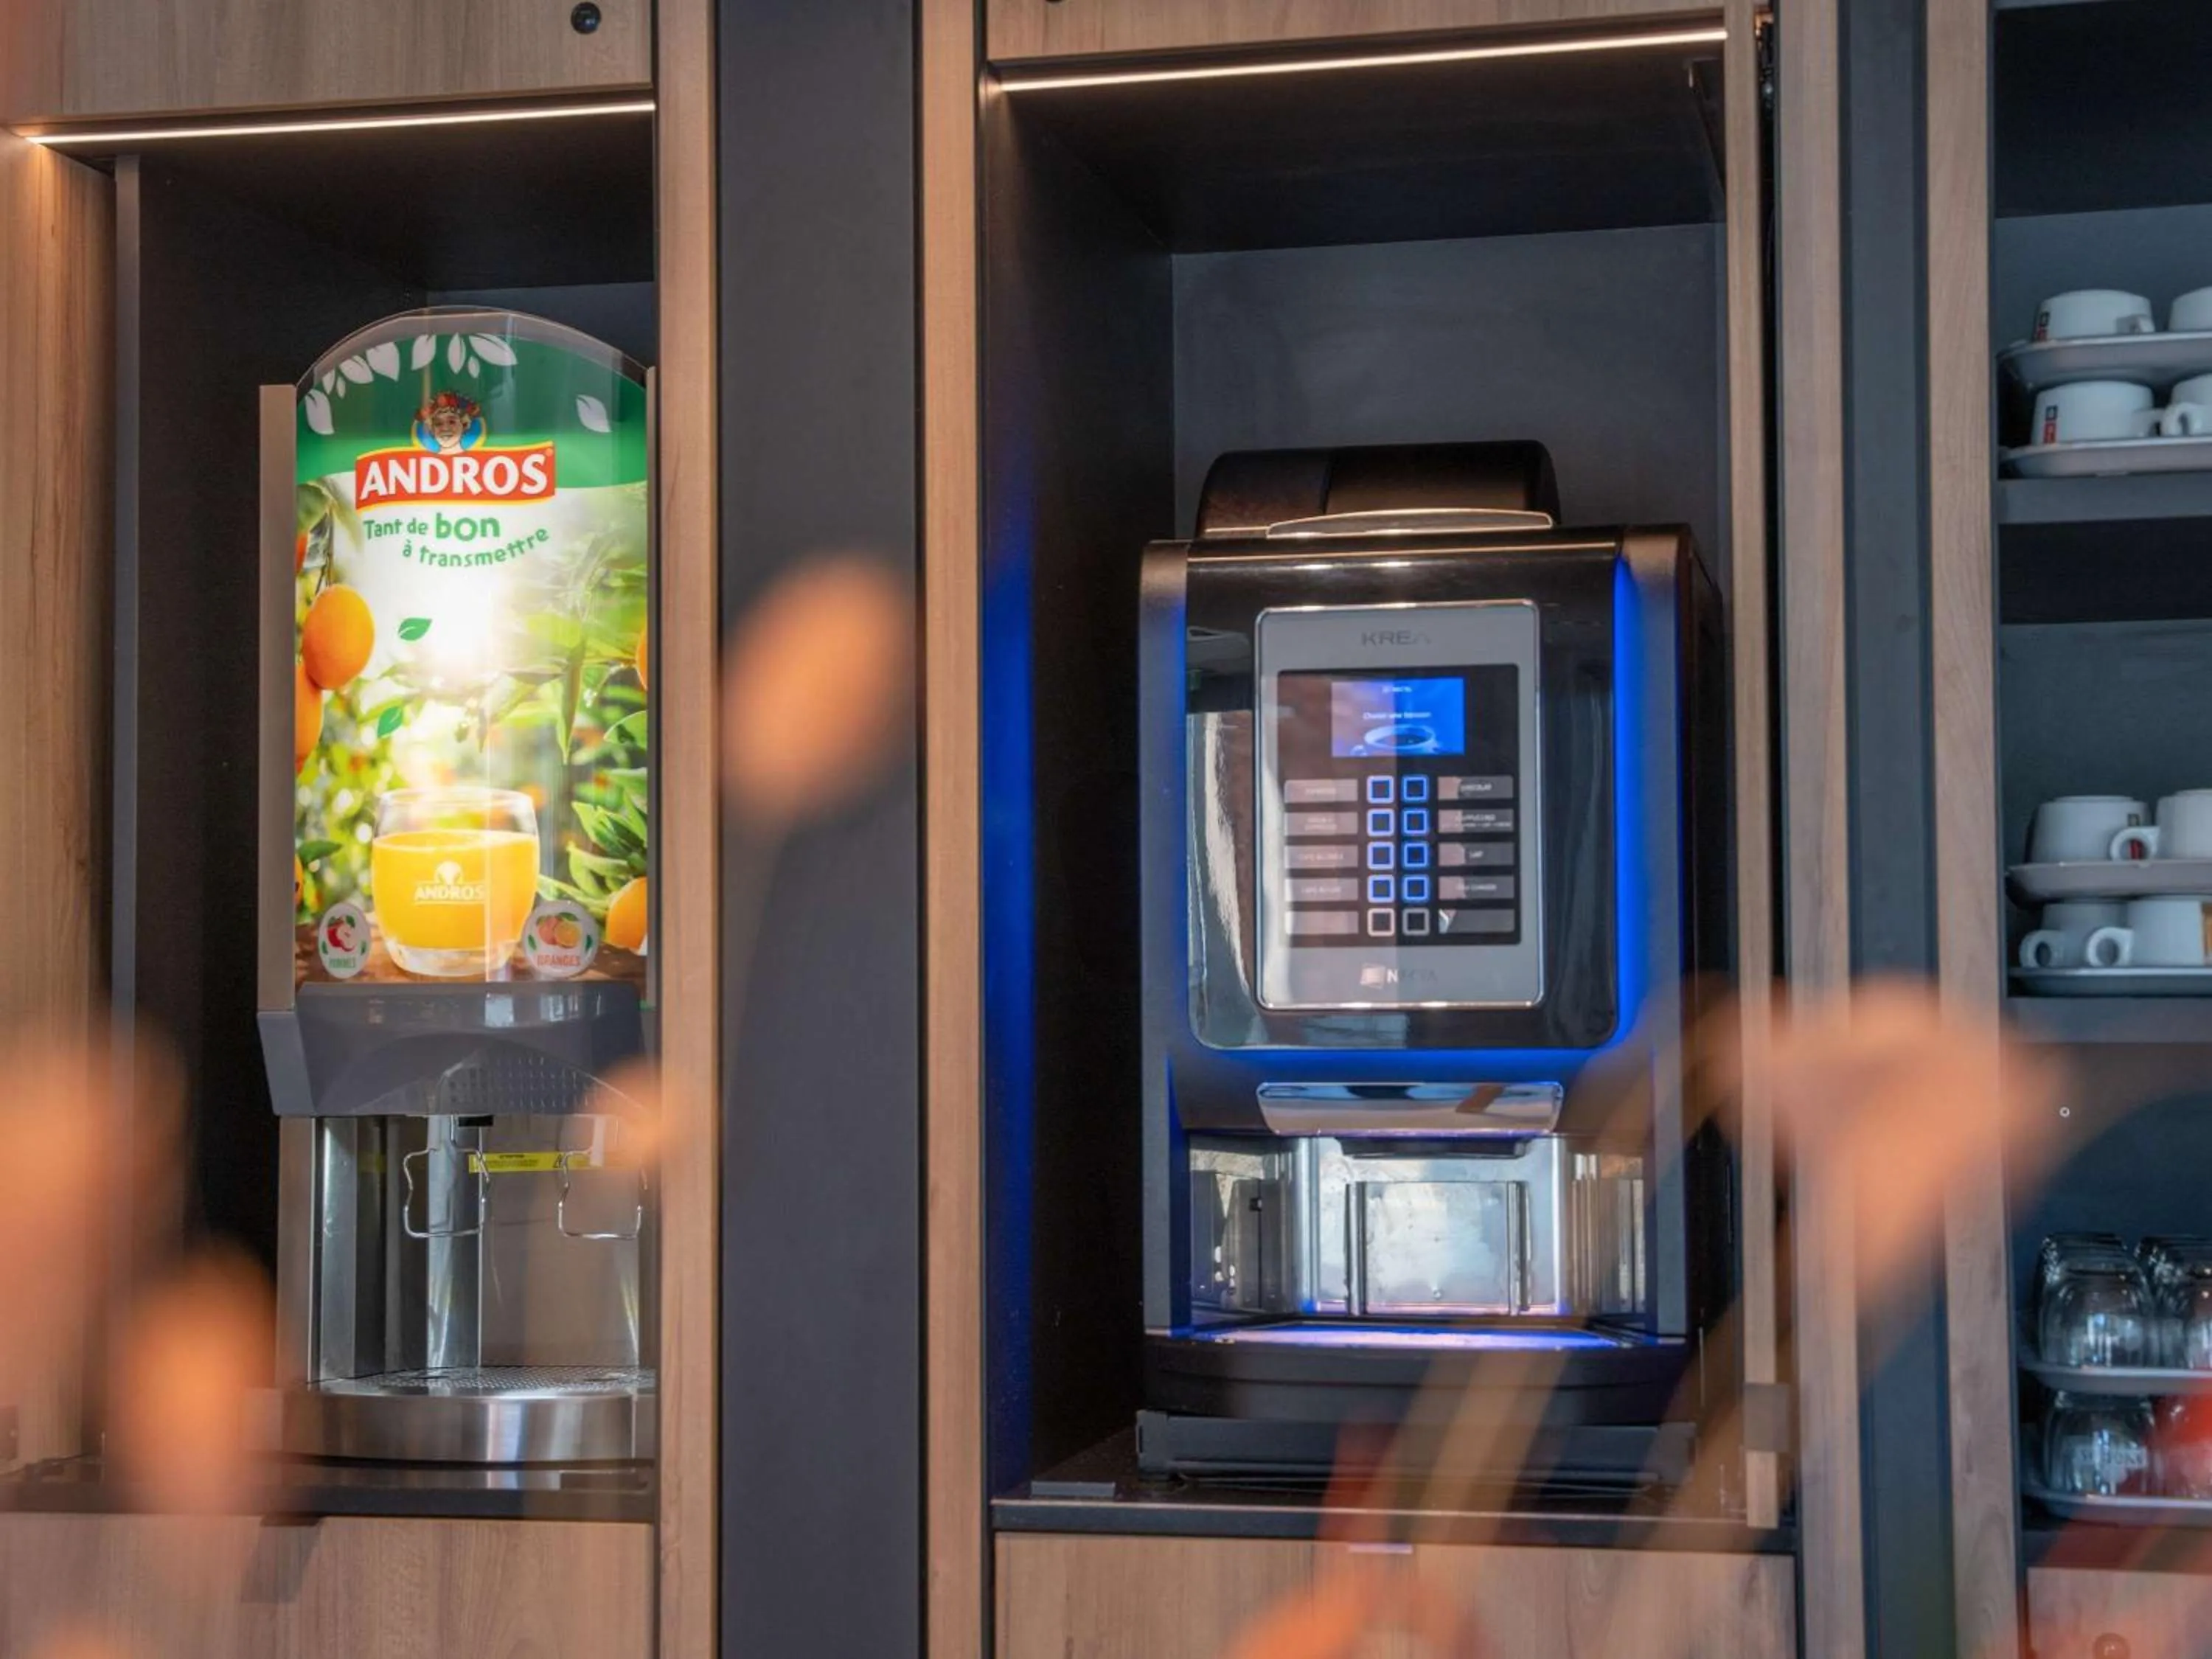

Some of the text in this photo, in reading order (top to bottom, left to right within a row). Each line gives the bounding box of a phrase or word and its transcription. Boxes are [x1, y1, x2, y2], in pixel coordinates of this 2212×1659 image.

[360, 453, 548, 501] ANDROS
[364, 513, 501, 541] Tant de bon
[403, 527, 549, 568] à transmettre
[414, 883, 487, 901] ANDROS
